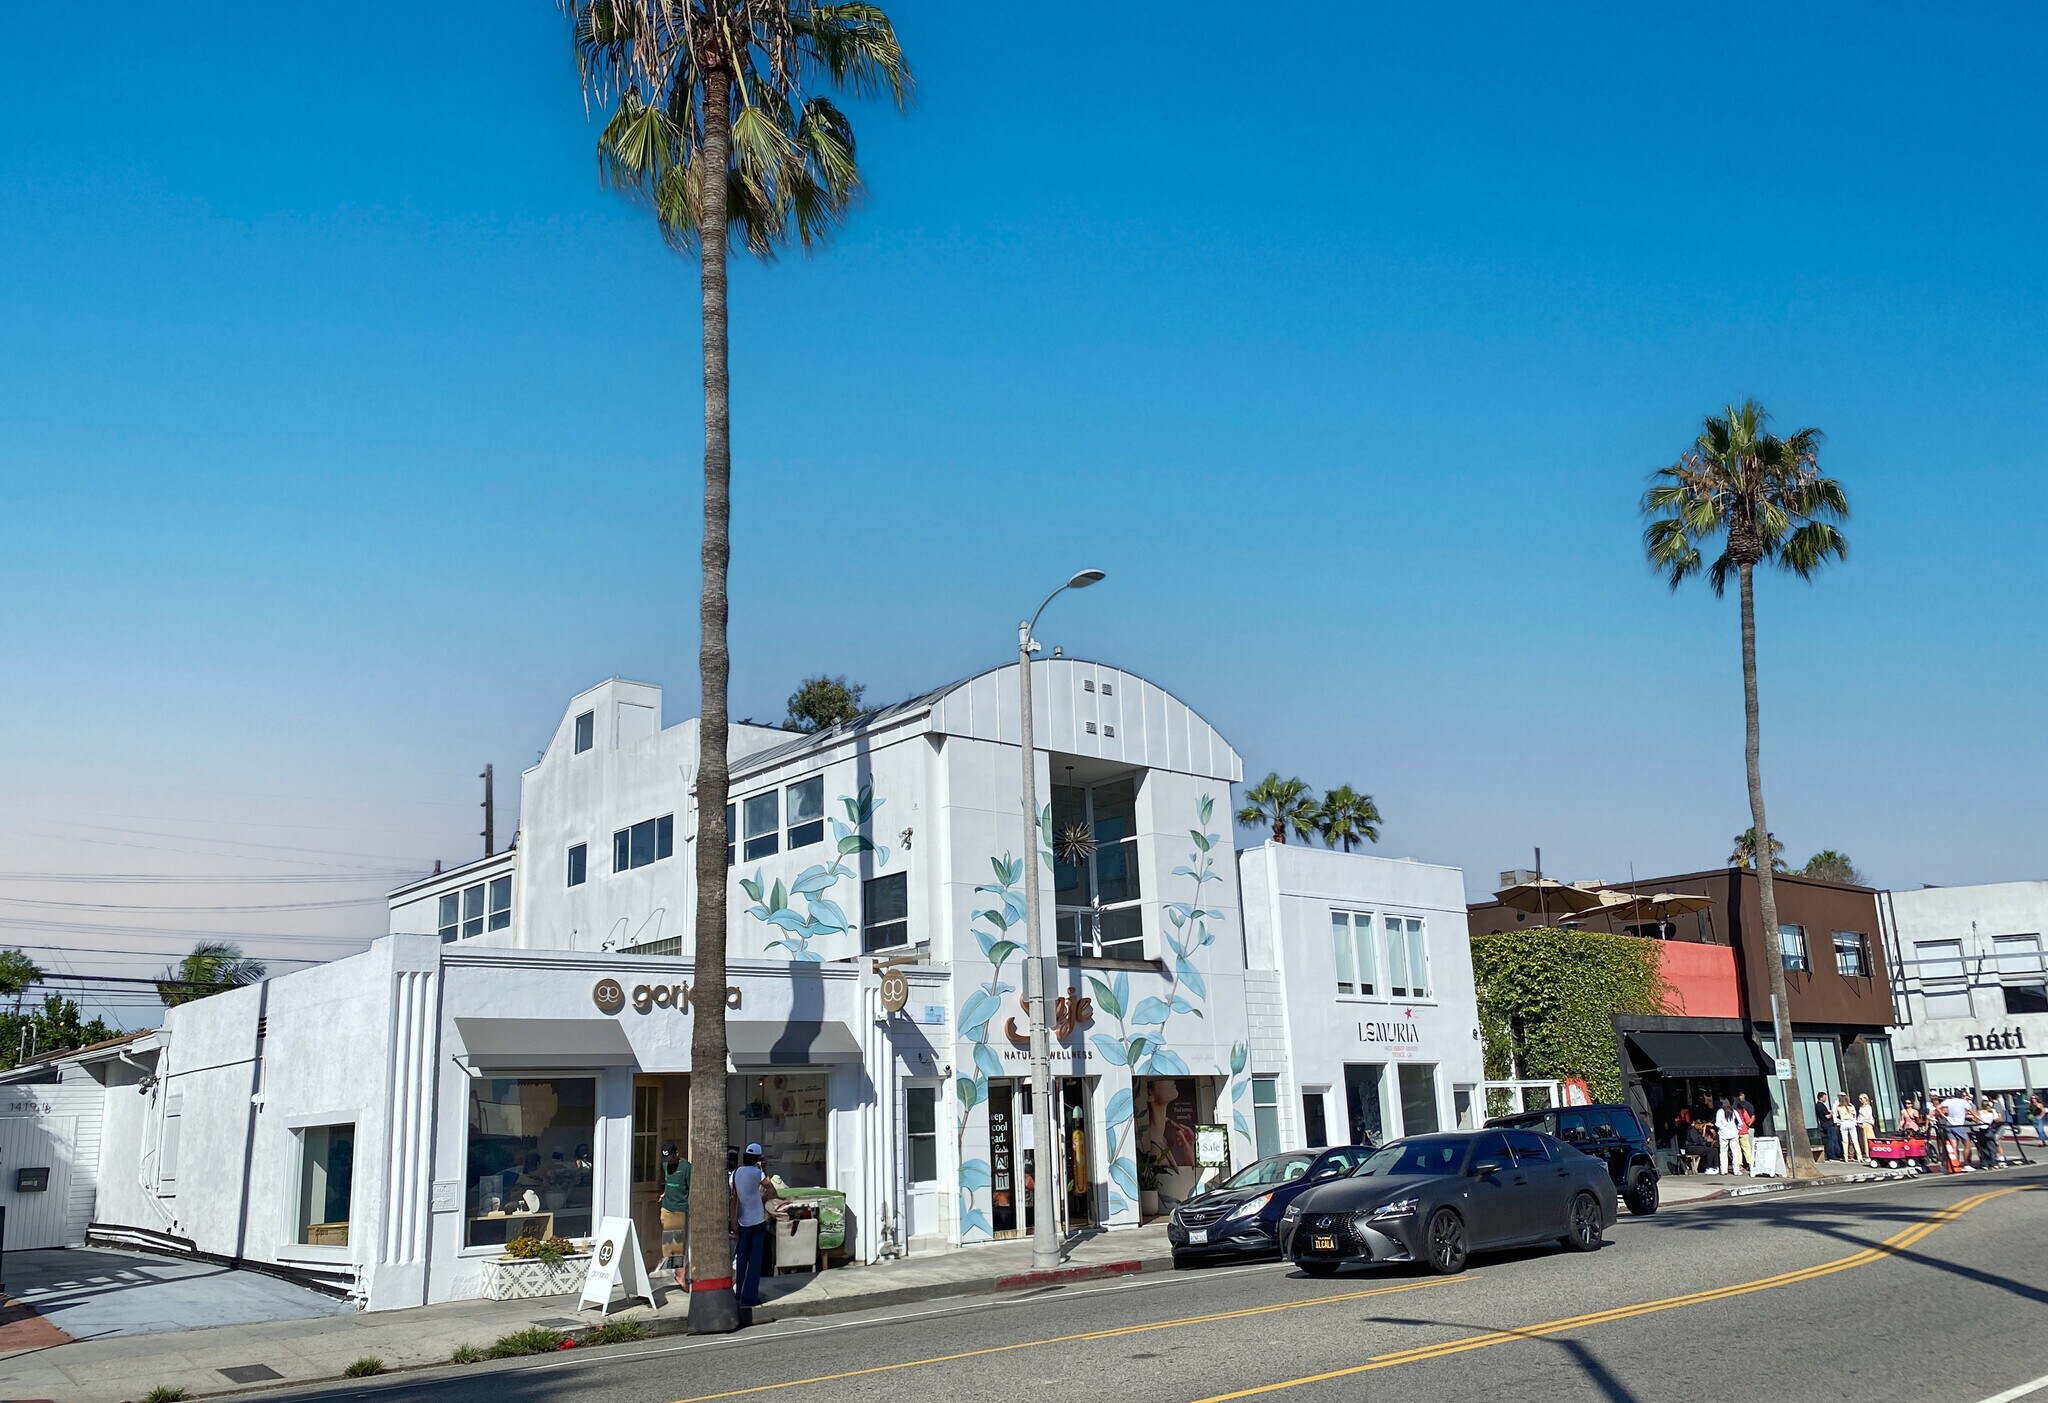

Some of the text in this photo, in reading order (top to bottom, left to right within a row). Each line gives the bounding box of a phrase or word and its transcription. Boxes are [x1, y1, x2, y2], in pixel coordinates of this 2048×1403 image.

[1358, 1022, 1419, 1042] LEMURIA
[1965, 1026, 2027, 1051] náti
[1050, 1051, 1093, 1060] WELLNESS
[1202, 1142, 1220, 1152] Sale
